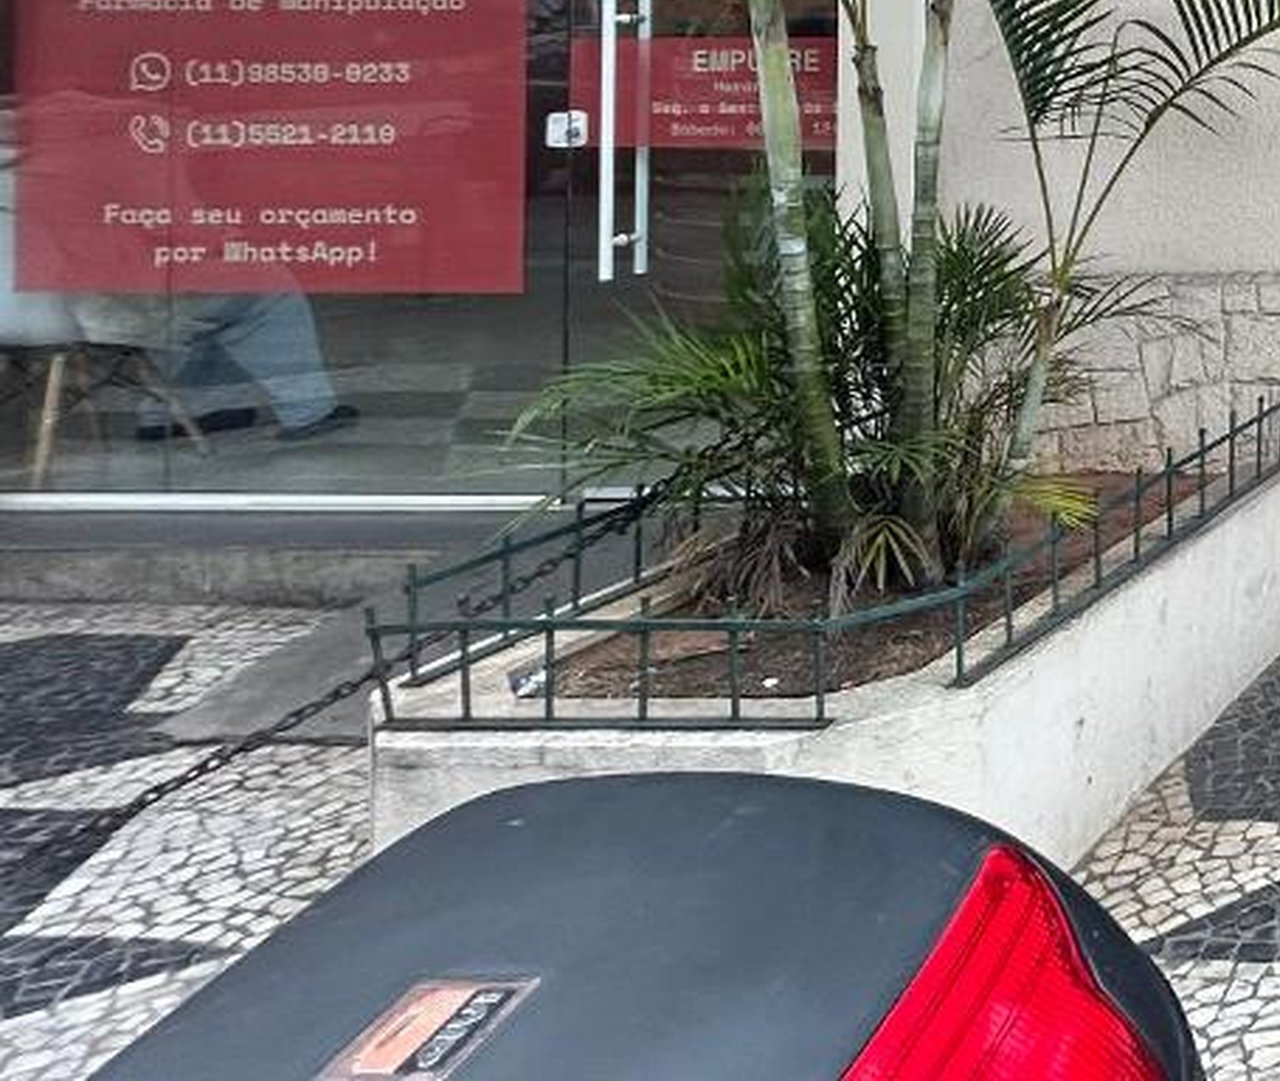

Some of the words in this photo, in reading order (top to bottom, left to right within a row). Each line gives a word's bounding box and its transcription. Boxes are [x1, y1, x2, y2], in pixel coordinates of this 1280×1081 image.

[104, 203, 171, 229] Faça
[191, 209, 242, 225] seu
[260, 206, 417, 230] orçamento
[155, 245, 206, 267] por
[224, 240, 378, 267] WhatsApp!
